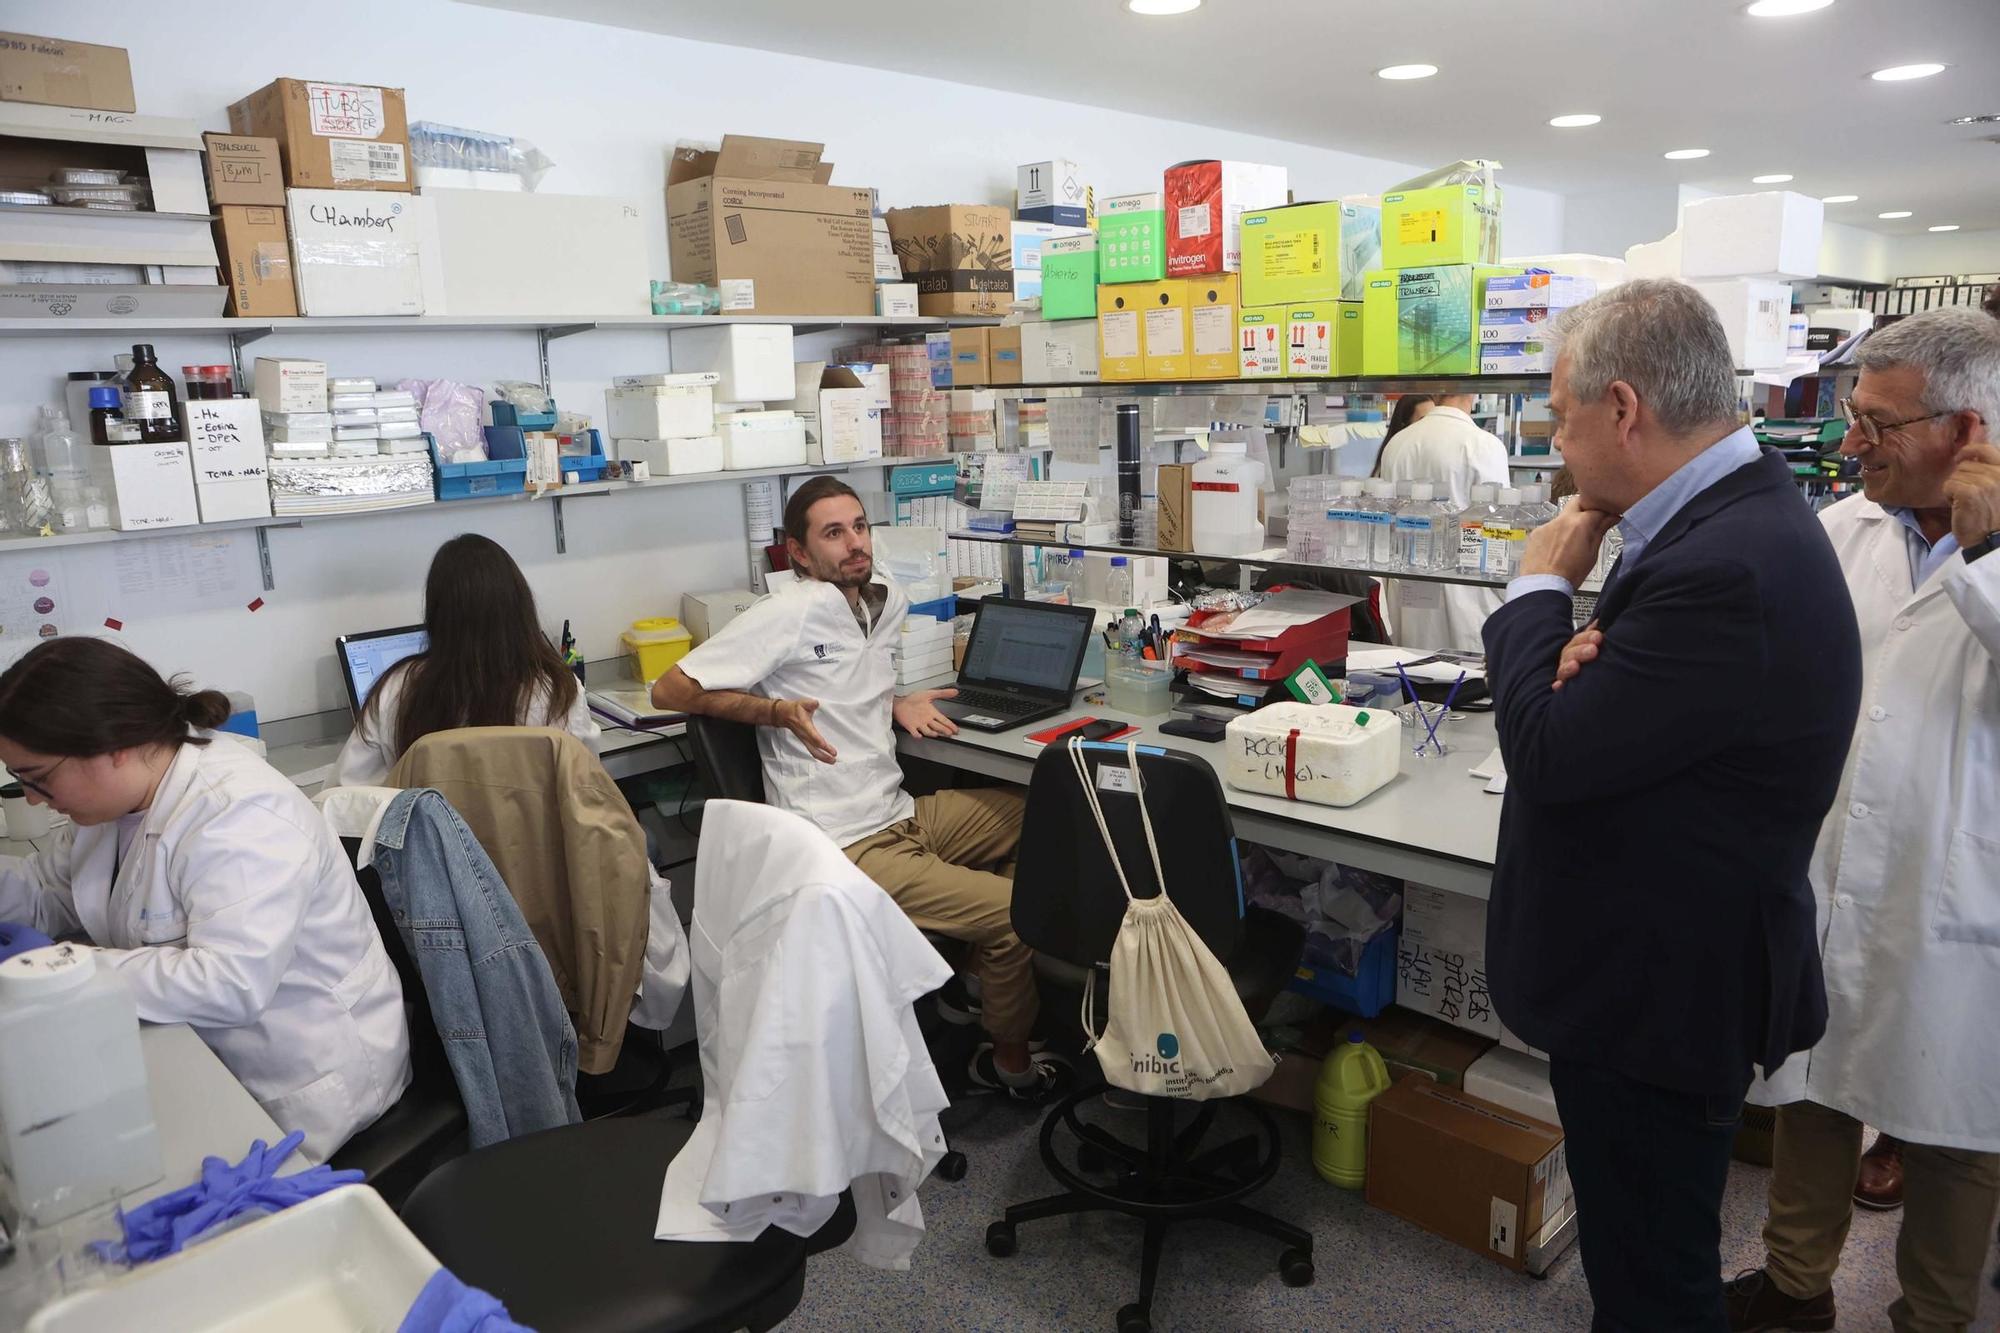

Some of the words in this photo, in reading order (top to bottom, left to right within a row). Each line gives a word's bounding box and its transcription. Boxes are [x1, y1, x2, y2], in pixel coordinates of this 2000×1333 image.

[722, 187, 747, 199] Corning
[747, 190, 785, 200] Incorporated
[1117, 199, 1141, 208] omega
[1059, 240, 1081, 249] omega
[1168, 253, 1206, 266] invitrogen
[978, 278, 1009, 291] deltalab
[1487, 297, 1503, 306] 100
[1530, 309, 1542, 317] XS
[1482, 329, 1499, 339] 100
[1310, 354, 1328, 362] FRAGILE
[1483, 362, 1498, 371] 100
[204, 421, 238, 432] Eosina
[208, 433, 241, 444] DPEX
